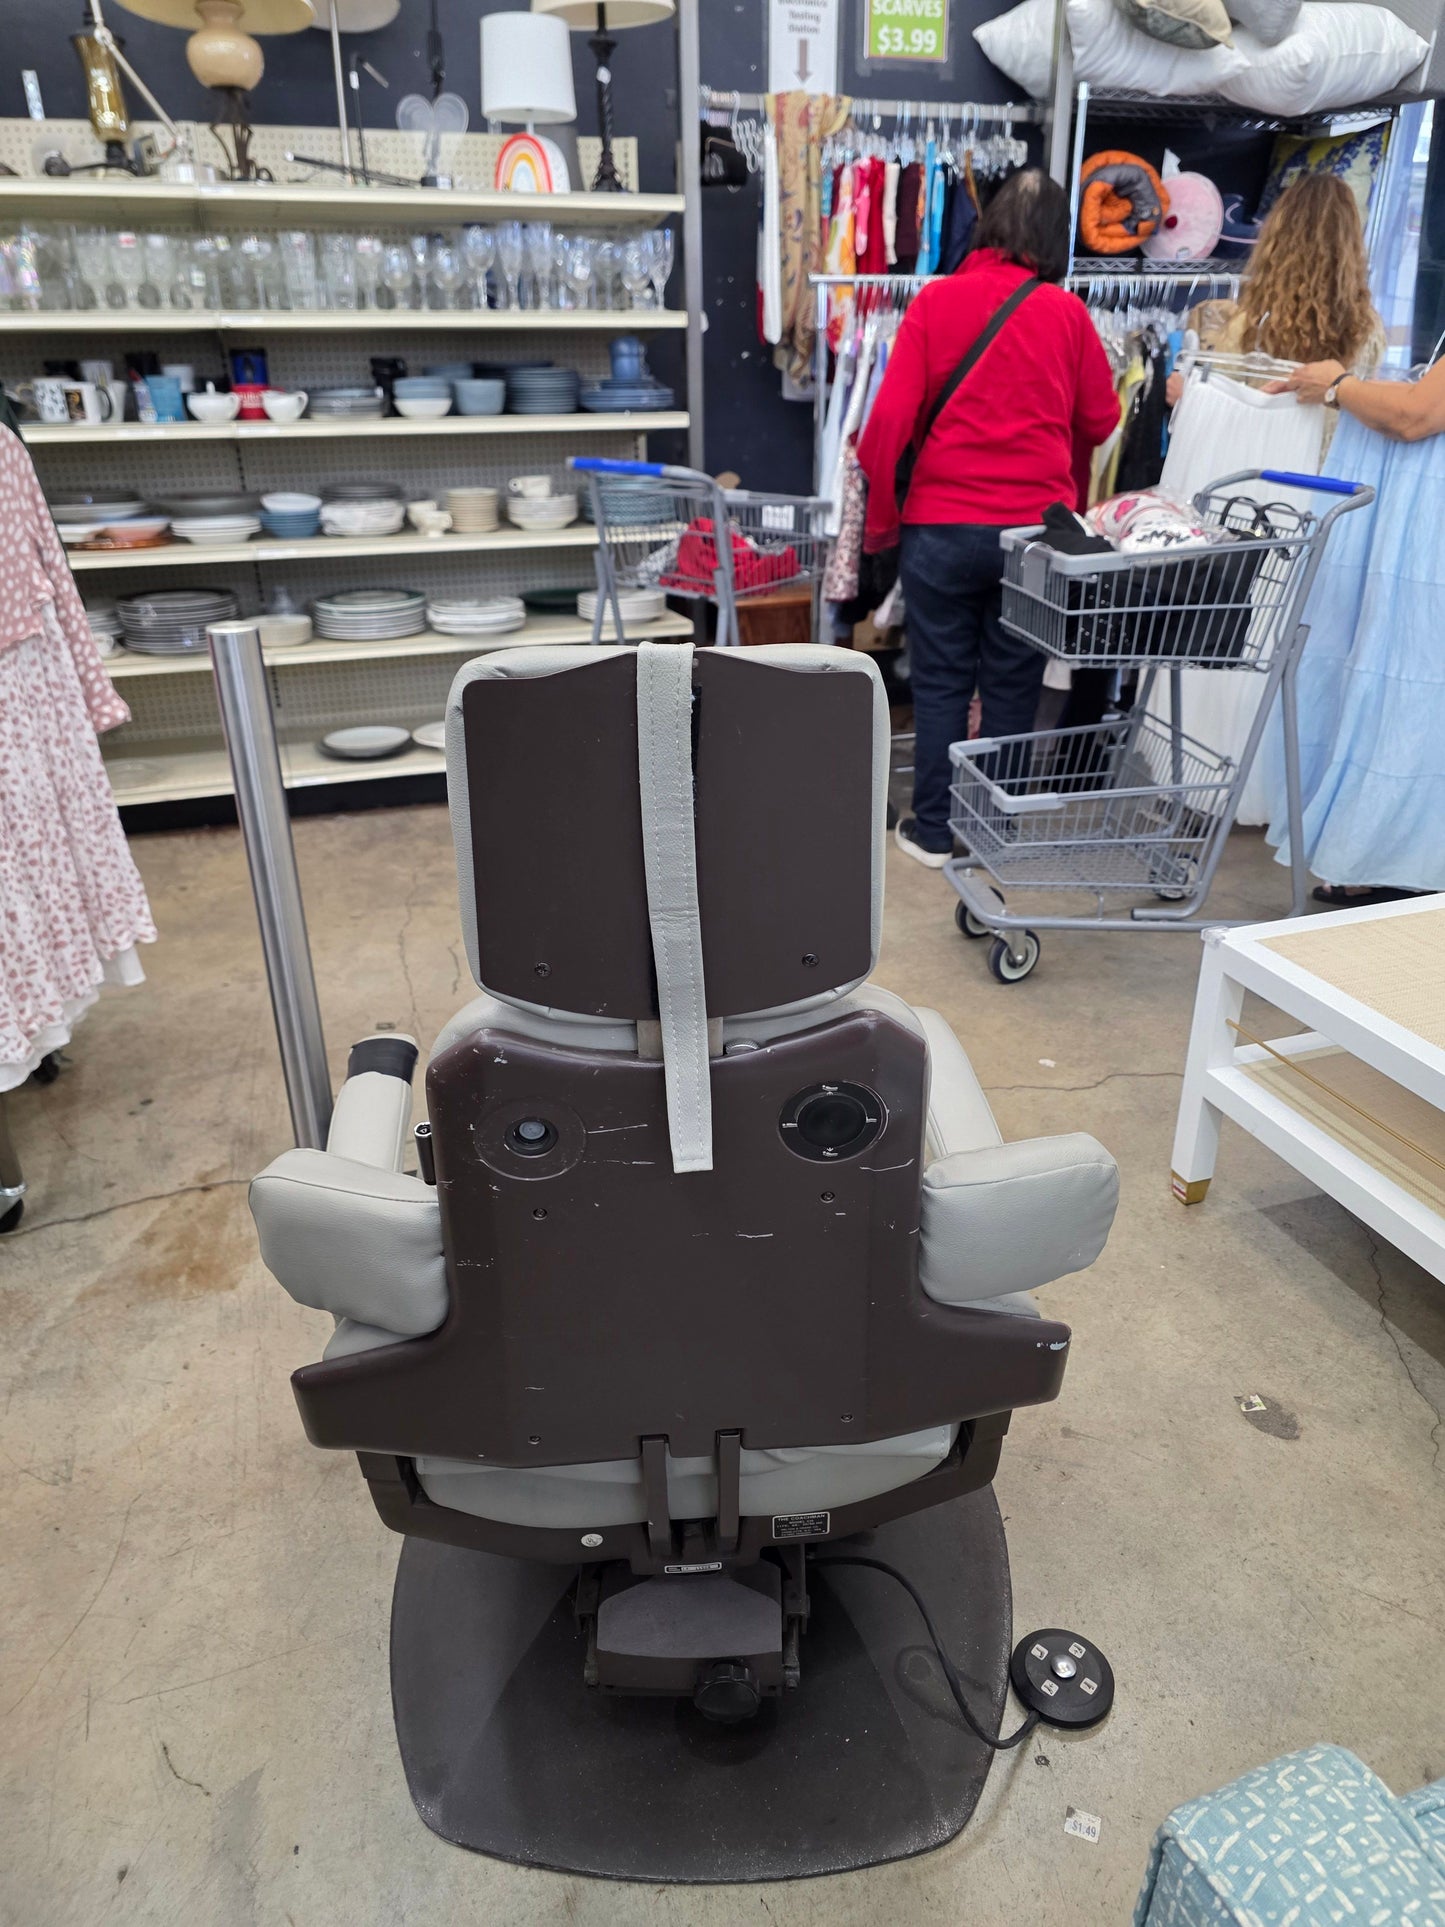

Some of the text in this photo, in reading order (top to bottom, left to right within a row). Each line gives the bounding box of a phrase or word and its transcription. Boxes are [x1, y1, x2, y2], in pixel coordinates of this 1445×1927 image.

[872, 0, 943, 18] SCARVES
[877, 24, 937, 56] $3.99
[1071, 1820, 1097, 1838] $1.49
